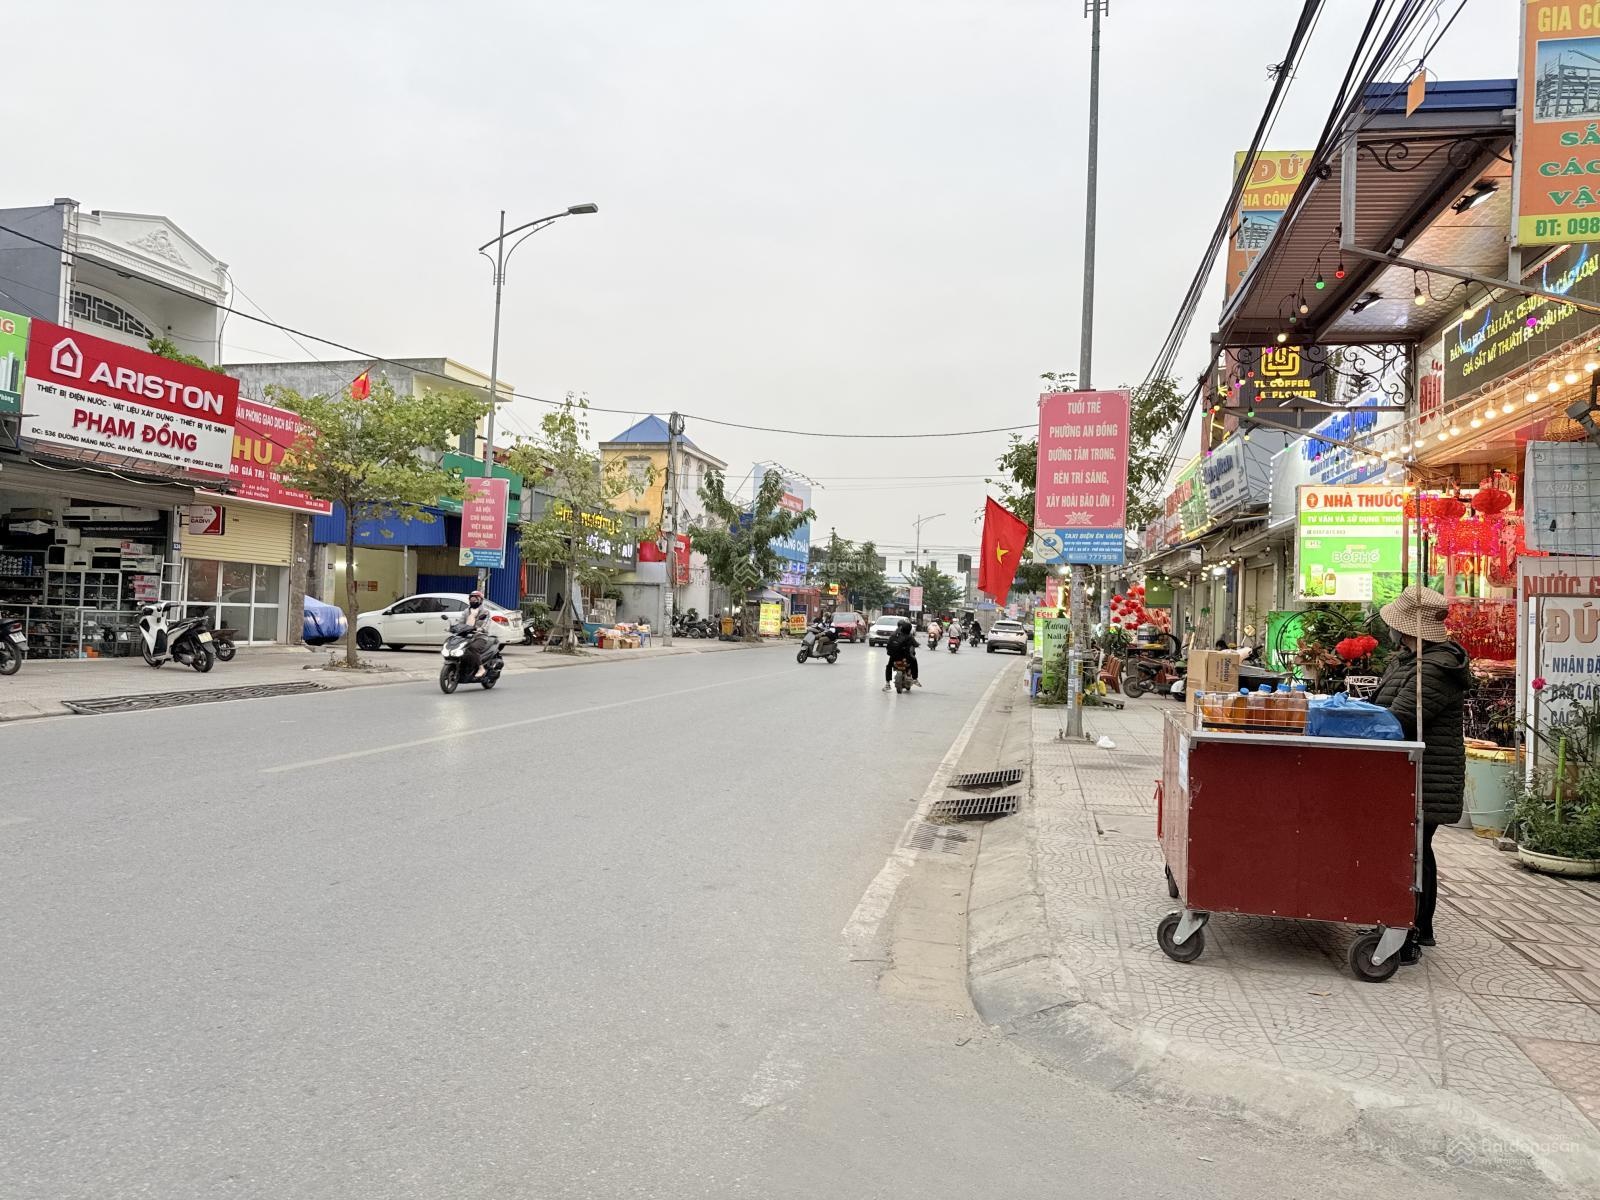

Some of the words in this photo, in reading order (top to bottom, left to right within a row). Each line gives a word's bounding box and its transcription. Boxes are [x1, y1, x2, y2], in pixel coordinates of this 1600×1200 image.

[1538, 5, 1572, 32] GIA
[1536, 218, 1561, 237] ĐT:
[1567, 216, 1600, 234] 098
[1462, 361, 1474, 377] GIÁ
[1487, 344, 1497, 363] MỸ
[89, 362, 224, 416] ARISTON
[1254, 380, 1265, 388] TL
[1272, 390, 1317, 399] FLOWER
[37, 383, 57, 395] THIẾT
[60, 390, 67, 399] BỊ
[69, 392, 85, 402] ĐIỆN
[87, 396, 107, 407] NƯỚC
[113, 402, 125, 412] VẬT
[126, 405, 140, 415] LIỆU
[141, 408, 154, 418] XÂY
[156, 412, 174, 423] DỰNG
[180, 418, 195, 429] THIẾT
[197, 422, 203, 431] BỊ
[205, 424, 213, 433] VỆ
[214, 426, 227, 435] SINH
[1068, 397, 1085, 415] TUỔI
[1087, 397, 1102, 414] TRẺ
[246, 407, 262, 424] PHÒNG
[262, 412, 274, 426] GIAO
[274, 416, 285, 431] DỊCH
[285, 417, 294, 432] BẤT
[31, 427, 43, 435] ĐC:
[58, 432, 80, 442] ĐƯỜNG
[73, 409, 135, 439] PHẠM
[142, 422, 197, 452] ĐỒNG
[1049, 422, 1081, 438] PHƯỜNG
[1082, 425, 1094, 438] AN
[1095, 421, 1118, 437] ĐỒNG
[1073, 446, 1089, 461] TÂM
[1090, 447, 1116, 462] TRONG,
[241, 465, 253, 477] GIÁ
[254, 469, 265, 481] TRỊ
[1071, 469, 1083, 484] TRÍ
[1085, 469, 1109, 485] SÁNG,
[1046, 493, 1060, 508] XÂY
[1095, 492, 1110, 507] LỚN
[1323, 491, 1353, 508] NHÀ
[1357, 488, 1403, 508] THUỐC
[1381, 514, 1402, 523] THUỐ
[1552, 654, 1584, 676] NHẬN
